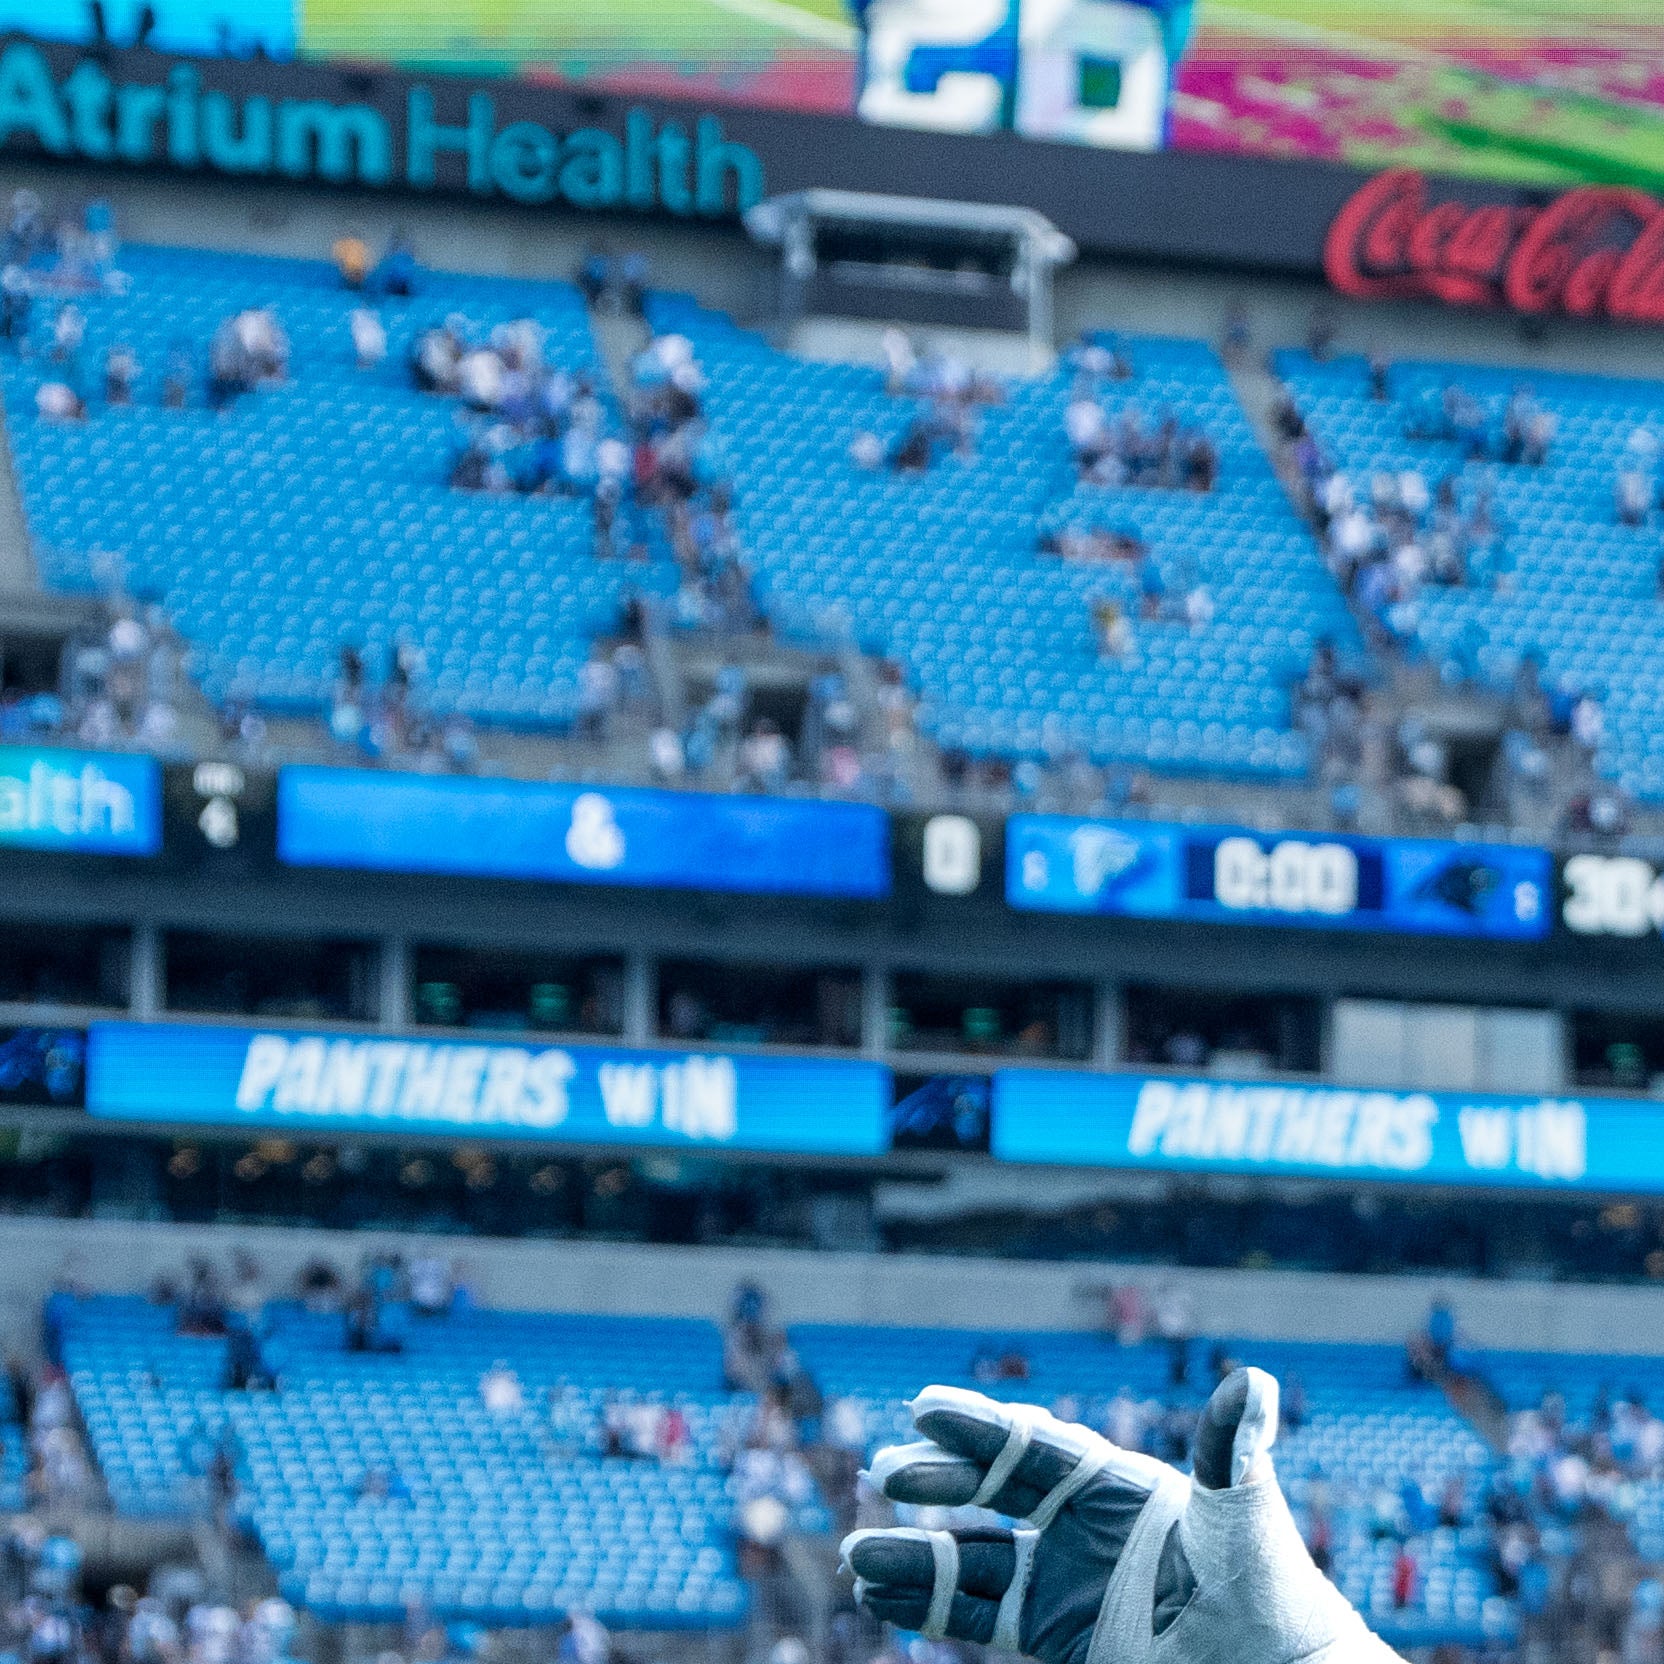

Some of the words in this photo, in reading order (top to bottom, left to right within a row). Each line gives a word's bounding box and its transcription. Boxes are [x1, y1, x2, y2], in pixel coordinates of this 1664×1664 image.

[0, 42, 392, 186] Atrium
[408, 85, 765, 213] Health
[922, 814, 982, 894] 0
[1213, 837, 1358, 915] 0:00
[236, 1033, 576, 1128] PANTHERS
[598, 1054, 737, 1140] WIN
[1127, 1080, 1439, 1170] PANTHERS
[1458, 1098, 1587, 1181] WIN
